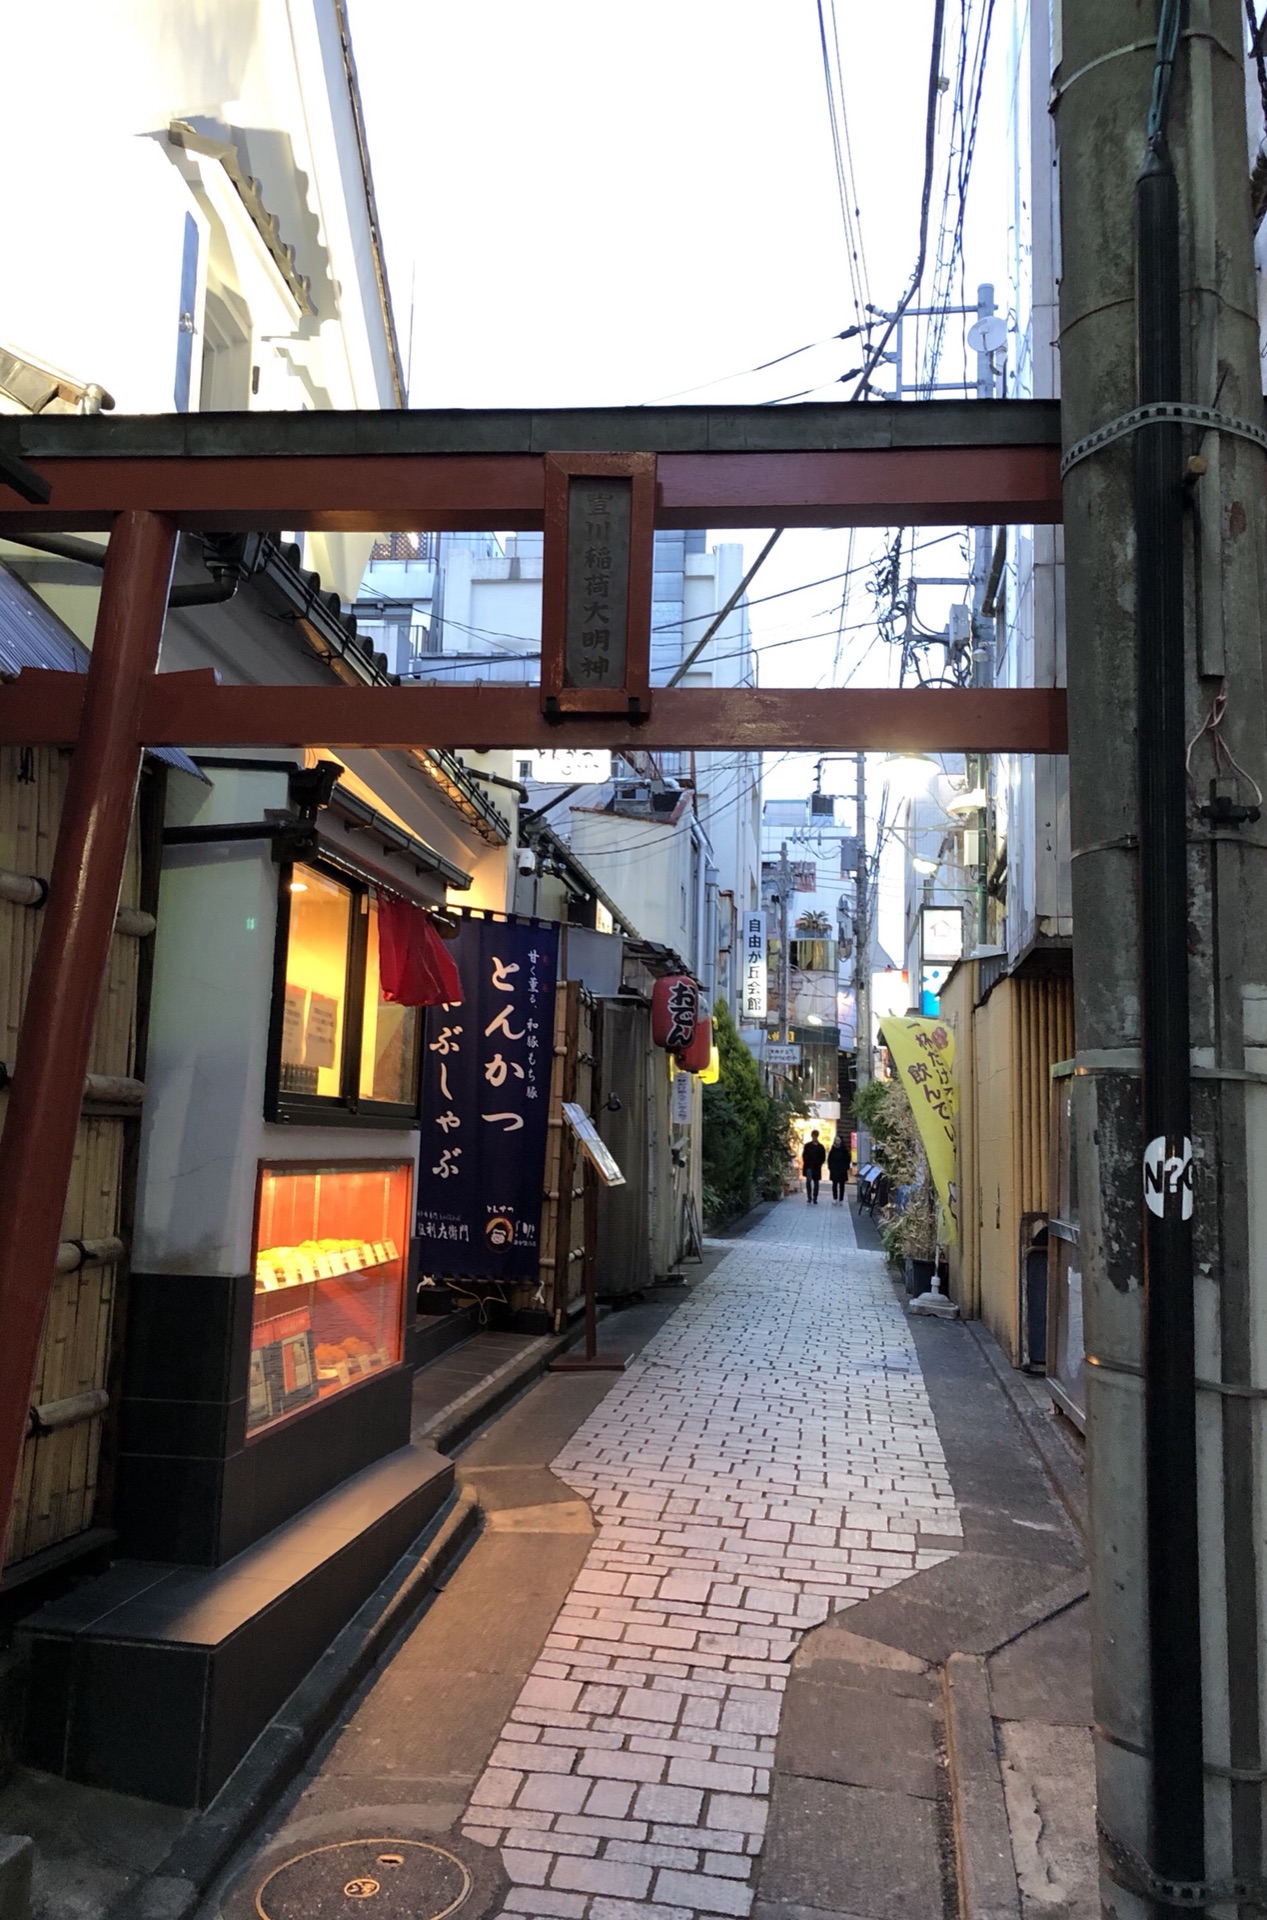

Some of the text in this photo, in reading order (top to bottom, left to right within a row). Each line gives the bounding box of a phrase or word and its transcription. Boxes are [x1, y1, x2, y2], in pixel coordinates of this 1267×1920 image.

[667, 981, 697, 1047] おでん
[747, 918, 763, 1012] 自由が丘会館
[430, 1001, 463, 1179] ぶしゃぶ
[481, 956, 526, 1133] とんかつ
